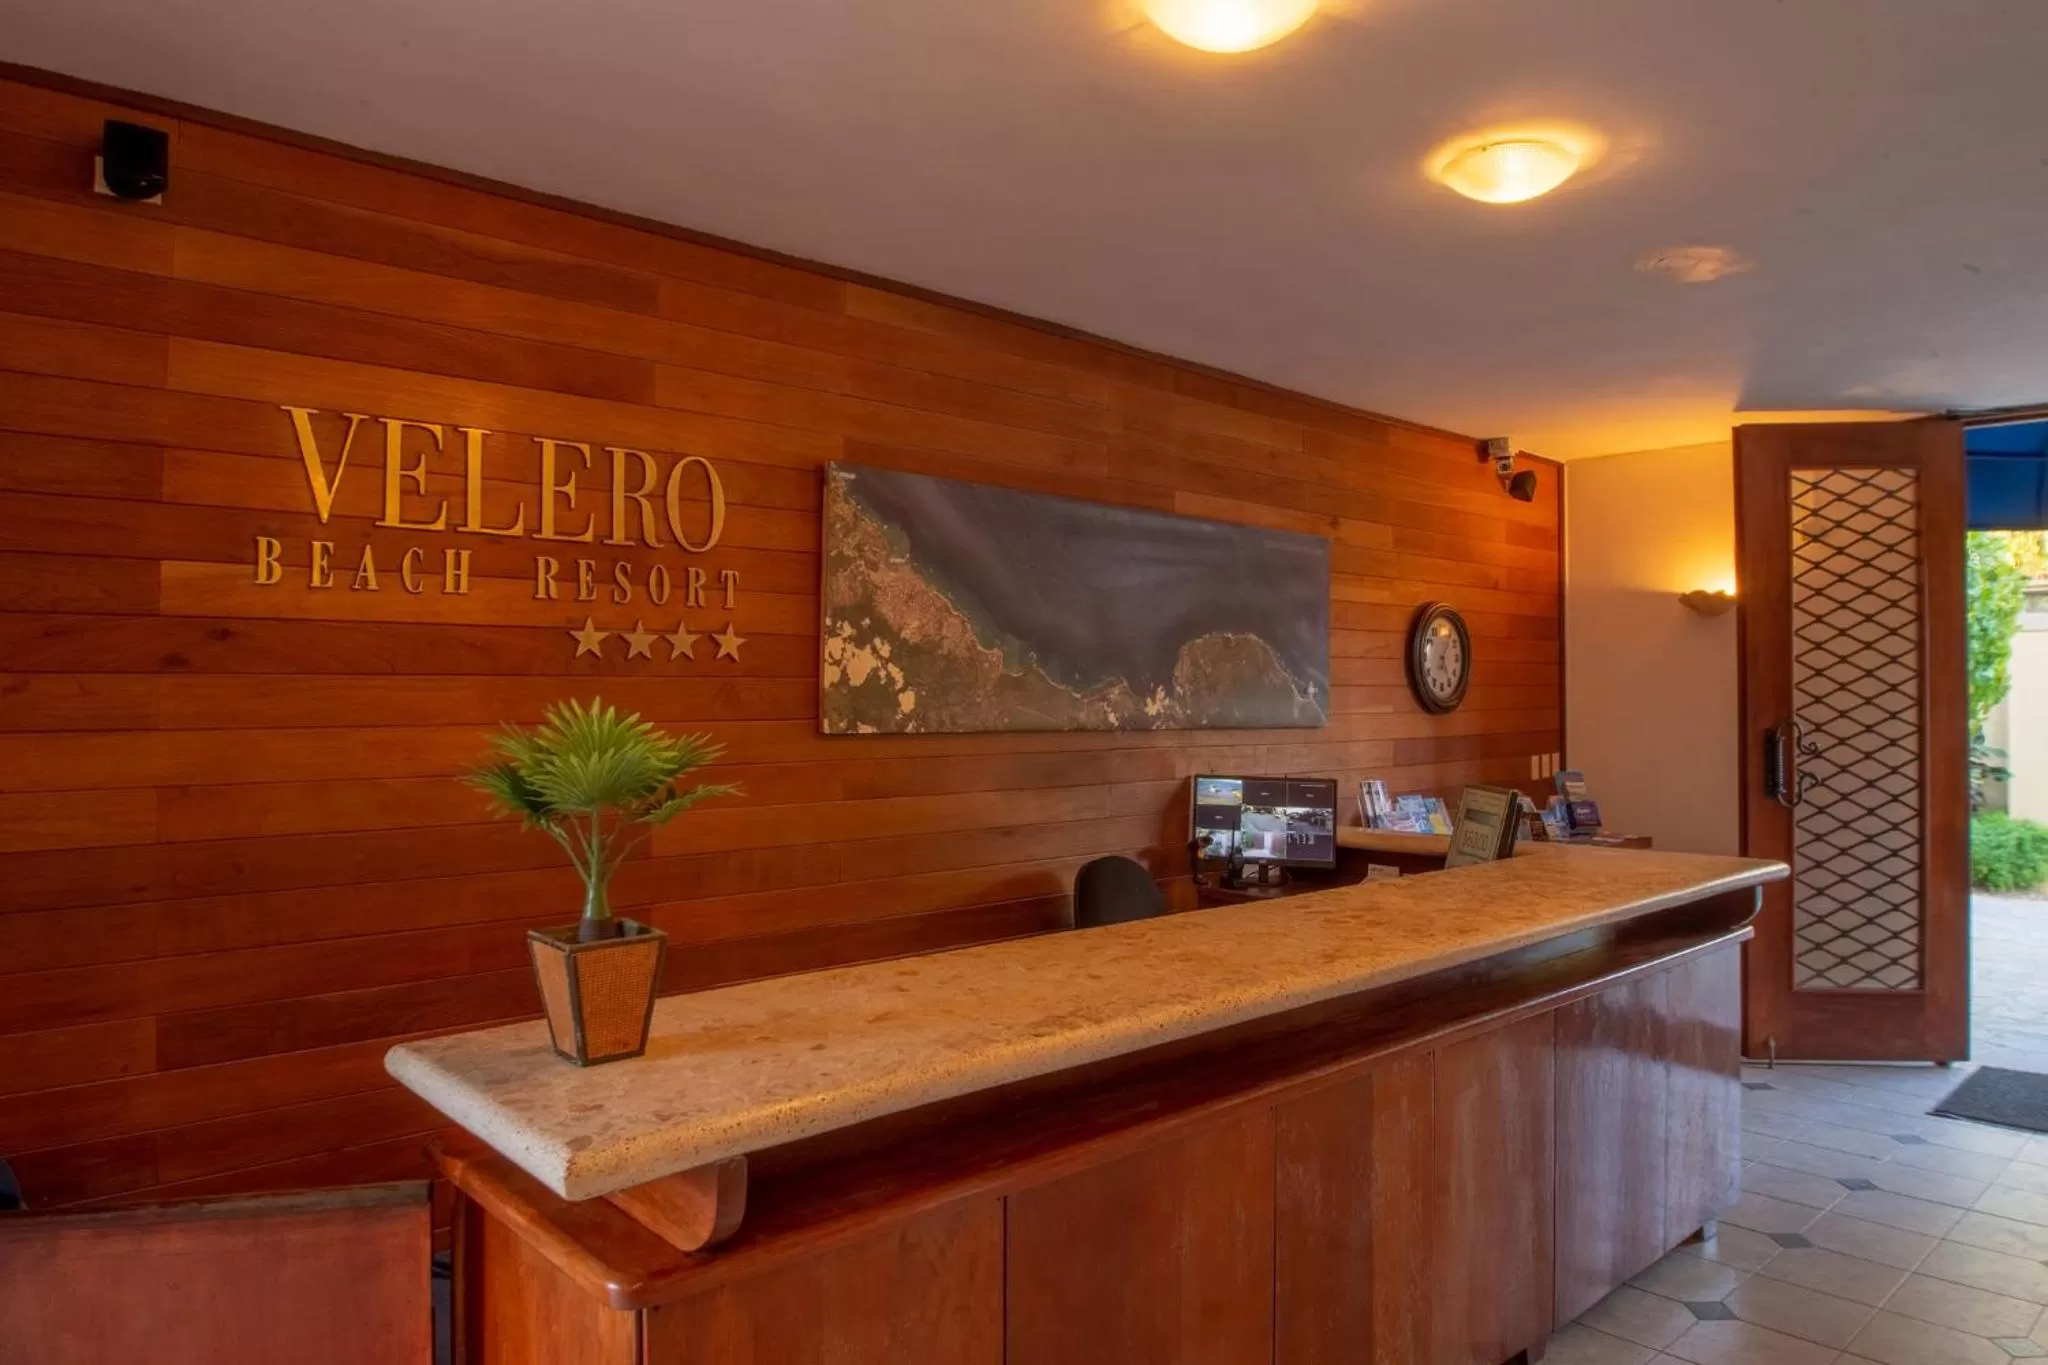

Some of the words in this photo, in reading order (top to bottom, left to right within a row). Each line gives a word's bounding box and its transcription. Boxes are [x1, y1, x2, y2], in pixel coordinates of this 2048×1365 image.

[280, 405, 726, 553] VELERO
[254, 536, 472, 594] BEACH
[534, 556, 741, 609] RESORT
